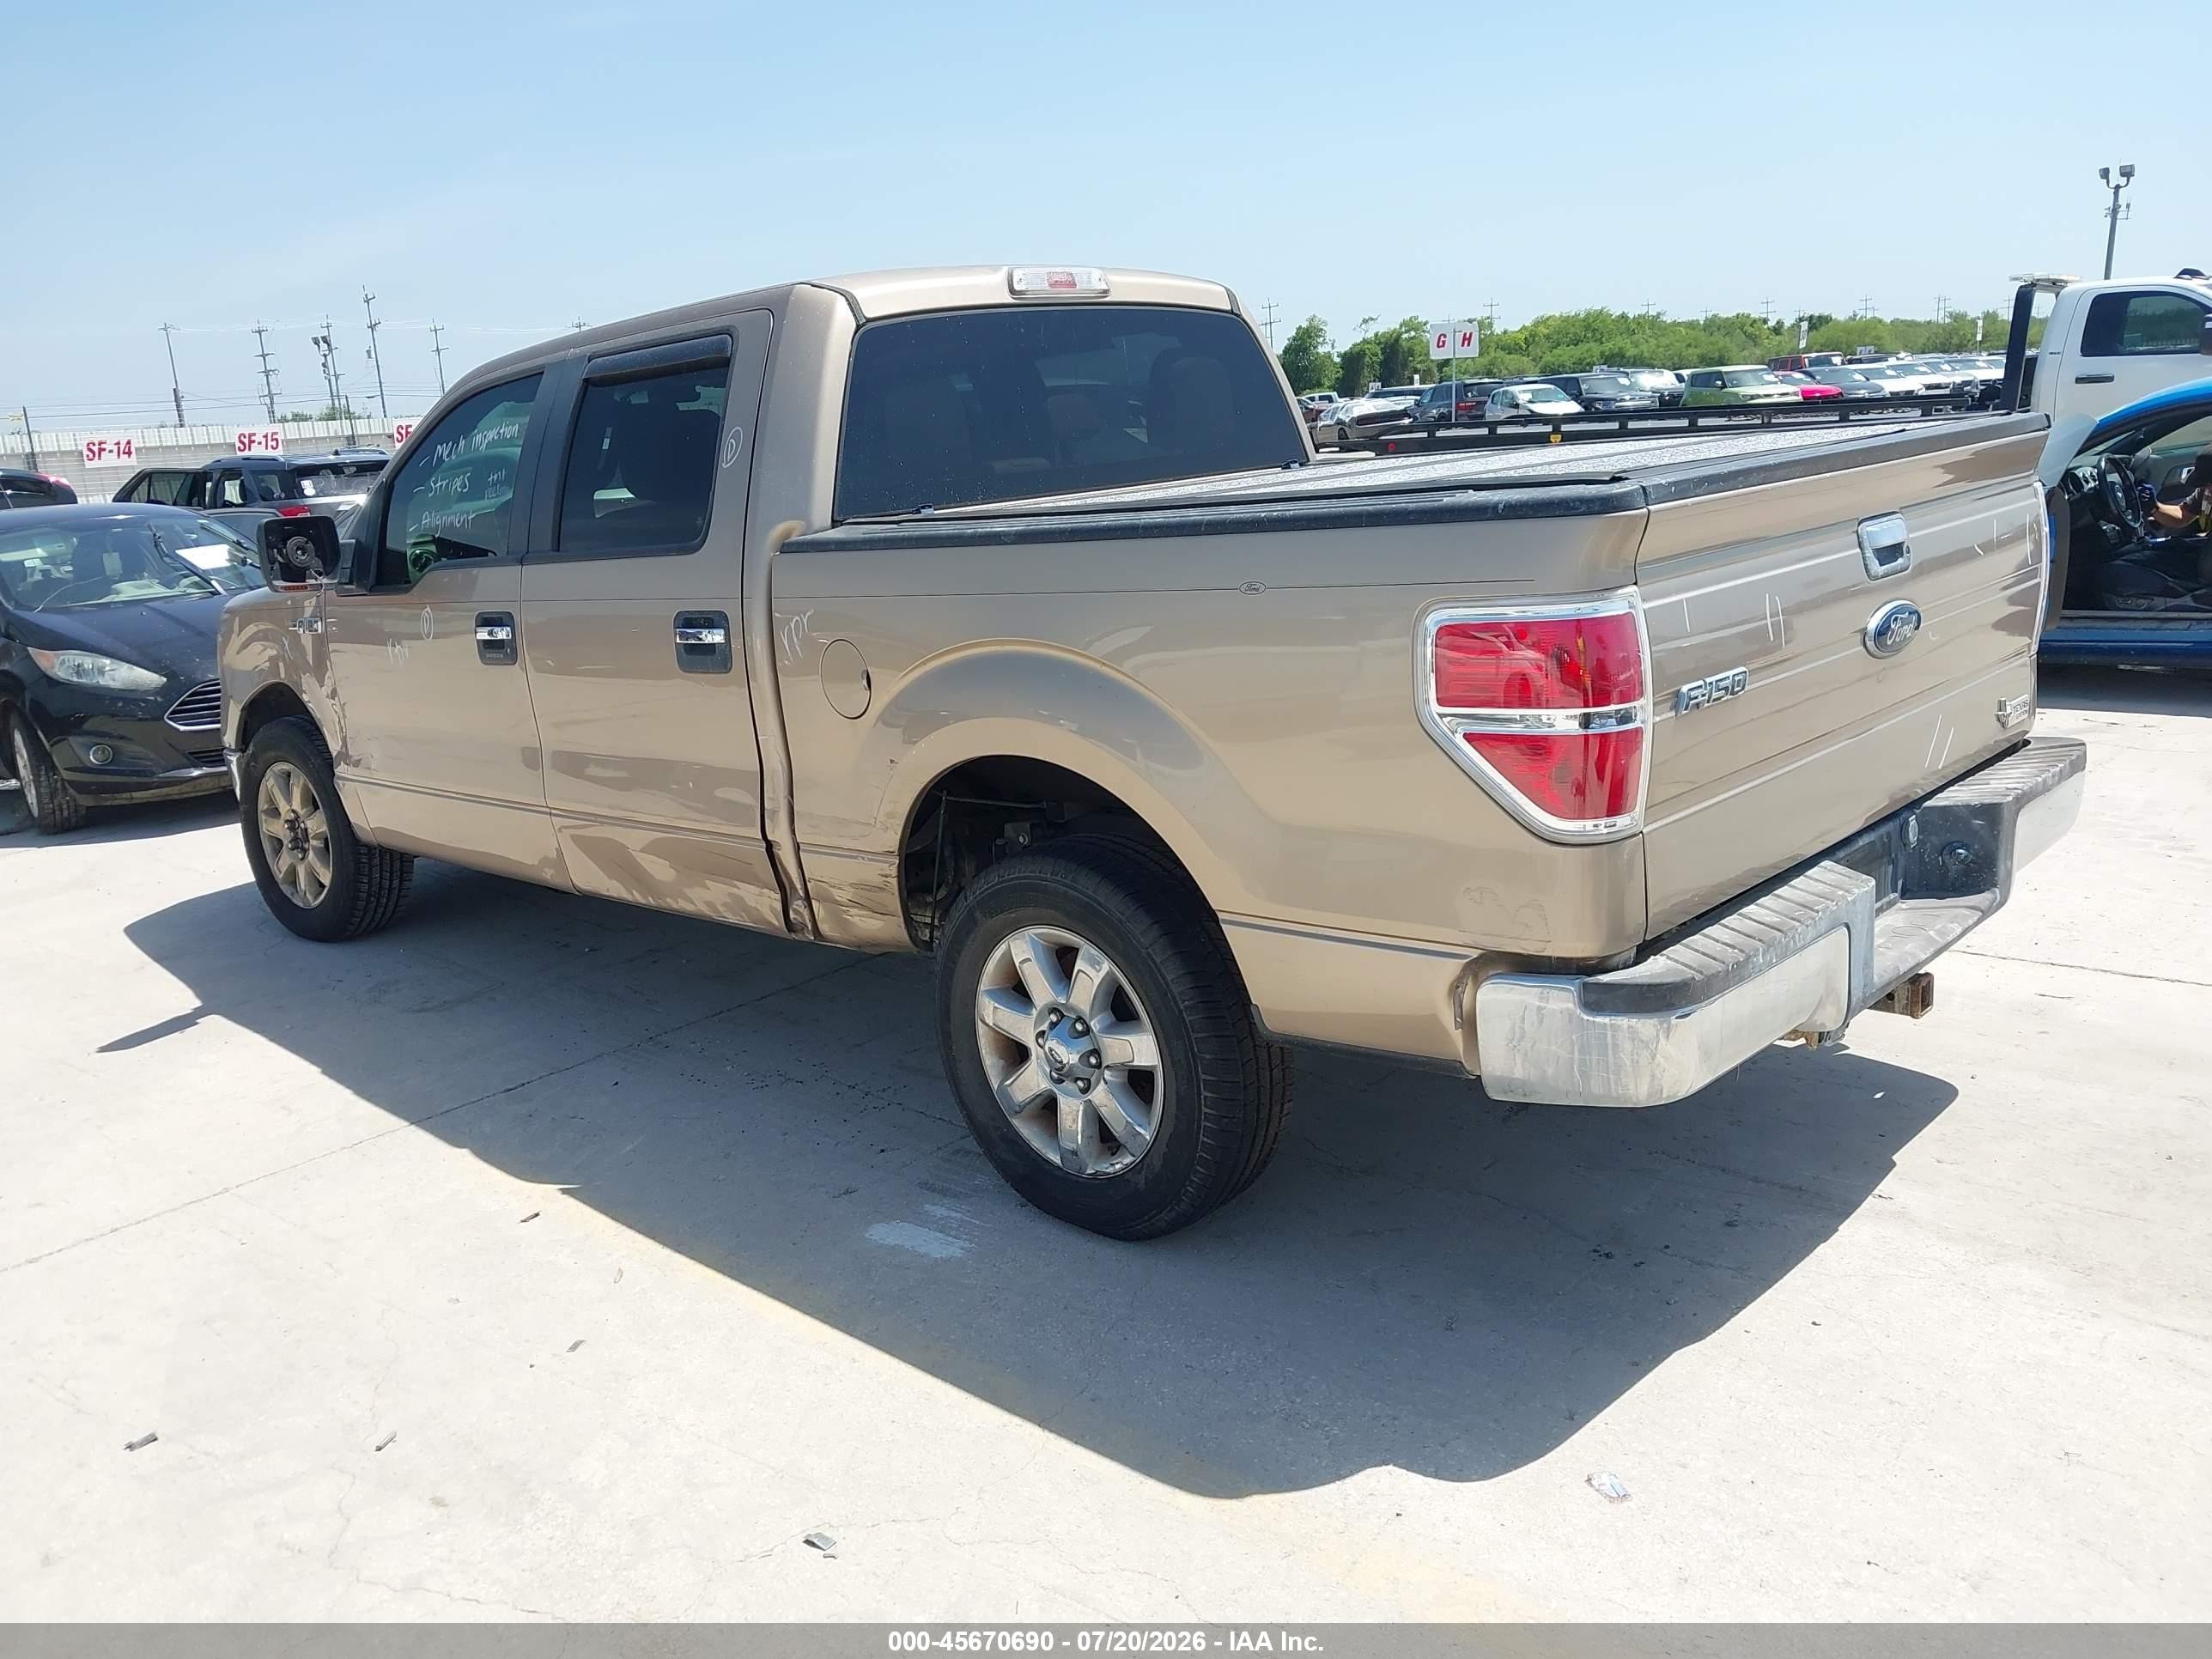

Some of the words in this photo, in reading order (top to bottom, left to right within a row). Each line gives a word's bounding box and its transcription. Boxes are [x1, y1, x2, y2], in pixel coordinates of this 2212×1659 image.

[1437, 333, 1447, 349] G
[1461, 331, 1473, 347] H
[238, 431, 279, 453] SF-15
[471, 421, 519, 452] inspection
[86, 439, 132, 461] SF-14
[421, 510, 476, 538] Alignment
[1887, 611, 1917, 645] Ford
